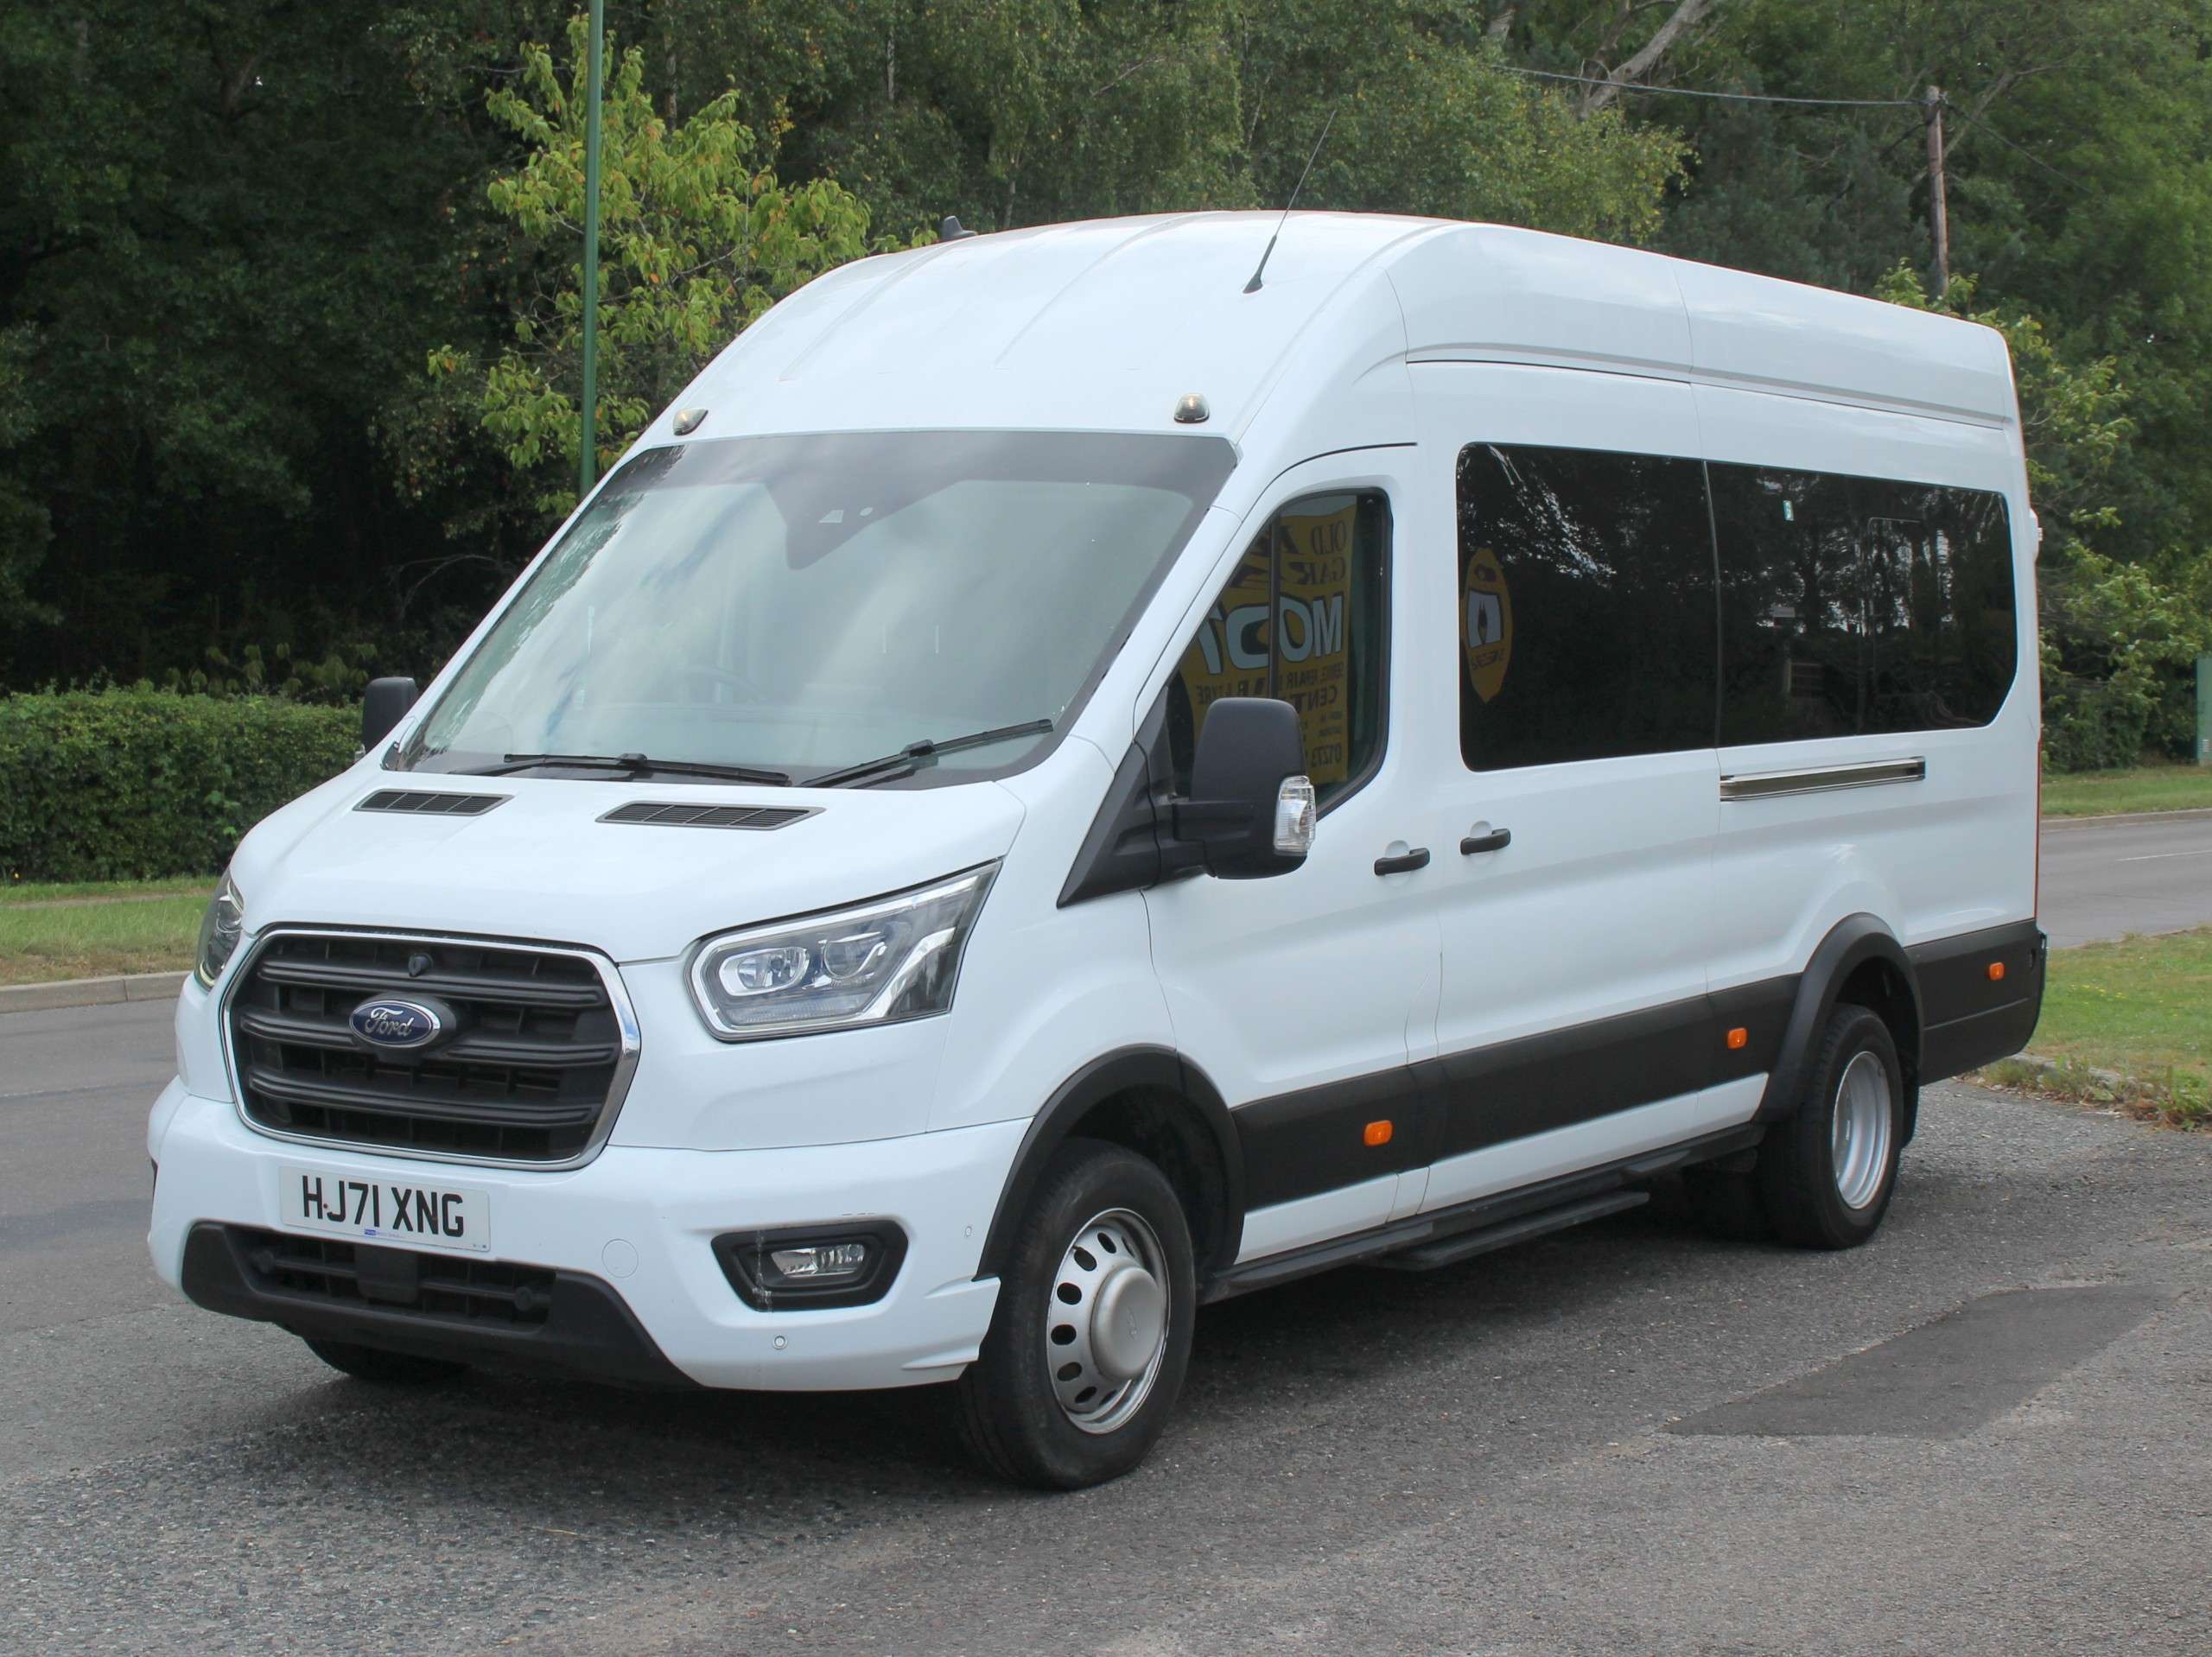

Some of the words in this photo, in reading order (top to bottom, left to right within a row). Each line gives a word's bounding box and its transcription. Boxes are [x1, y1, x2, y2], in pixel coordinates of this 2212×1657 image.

[365, 1007, 415, 1036] Ford
[302, 1175, 380, 1228] HJ71
[391, 1186, 464, 1238] XNG
